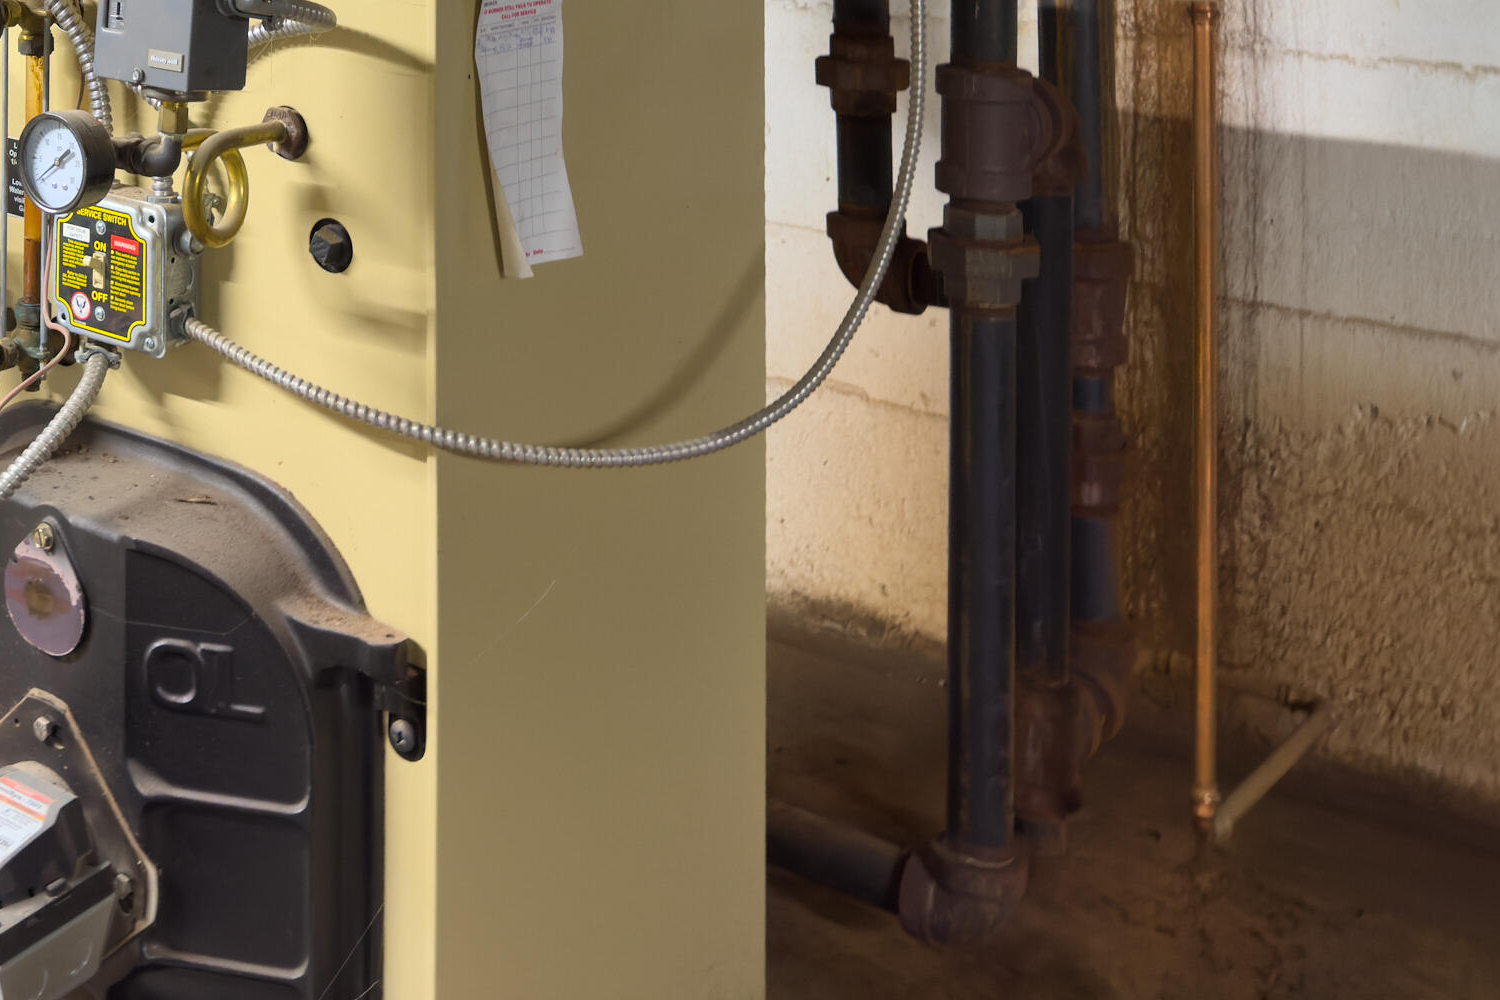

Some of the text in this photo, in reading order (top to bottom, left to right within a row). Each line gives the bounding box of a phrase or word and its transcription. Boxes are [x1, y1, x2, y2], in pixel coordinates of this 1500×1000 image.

[103, 212, 127, 226] SWITCH
[93, 240, 107, 253] ON
[91, 290, 108, 303] OFF
